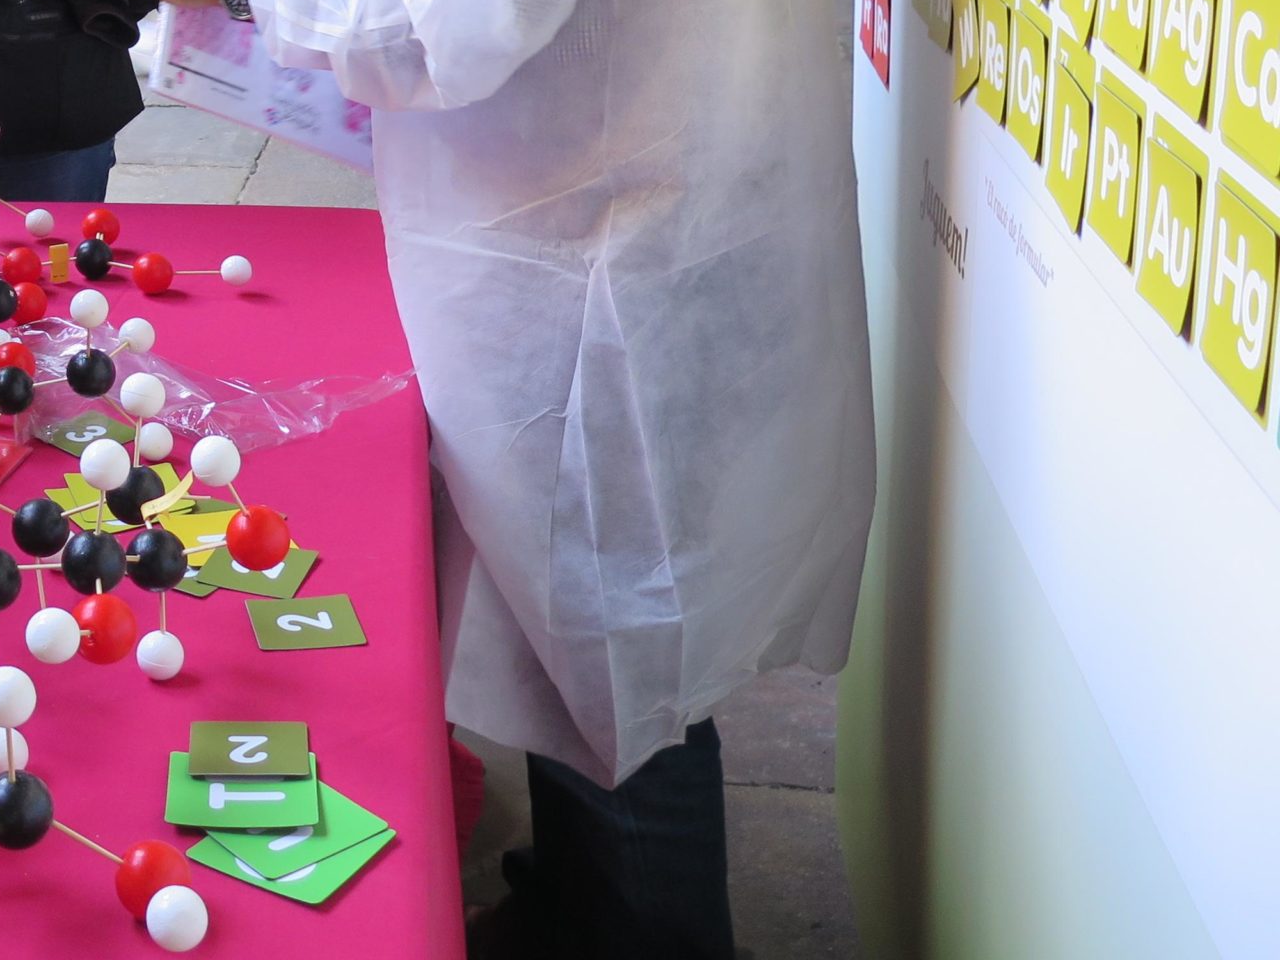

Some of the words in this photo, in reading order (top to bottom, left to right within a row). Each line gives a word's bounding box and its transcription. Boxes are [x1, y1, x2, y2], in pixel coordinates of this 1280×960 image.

[876, 4, 888, 57] Ra
[959, 0, 974, 69] W
[984, 20, 1004, 91] Re
[1017, 47, 1041, 126] Os
[1061, 103, 1078, 180] Ir
[1100, 126, 1130, 218] Pt
[1147, 184, 1190, 289] Au
[1213, 217, 1268, 370] Hg
[65, 425, 108, 443] 3
[276, 611, 333, 632] 2
[227, 735, 269, 764] 2
